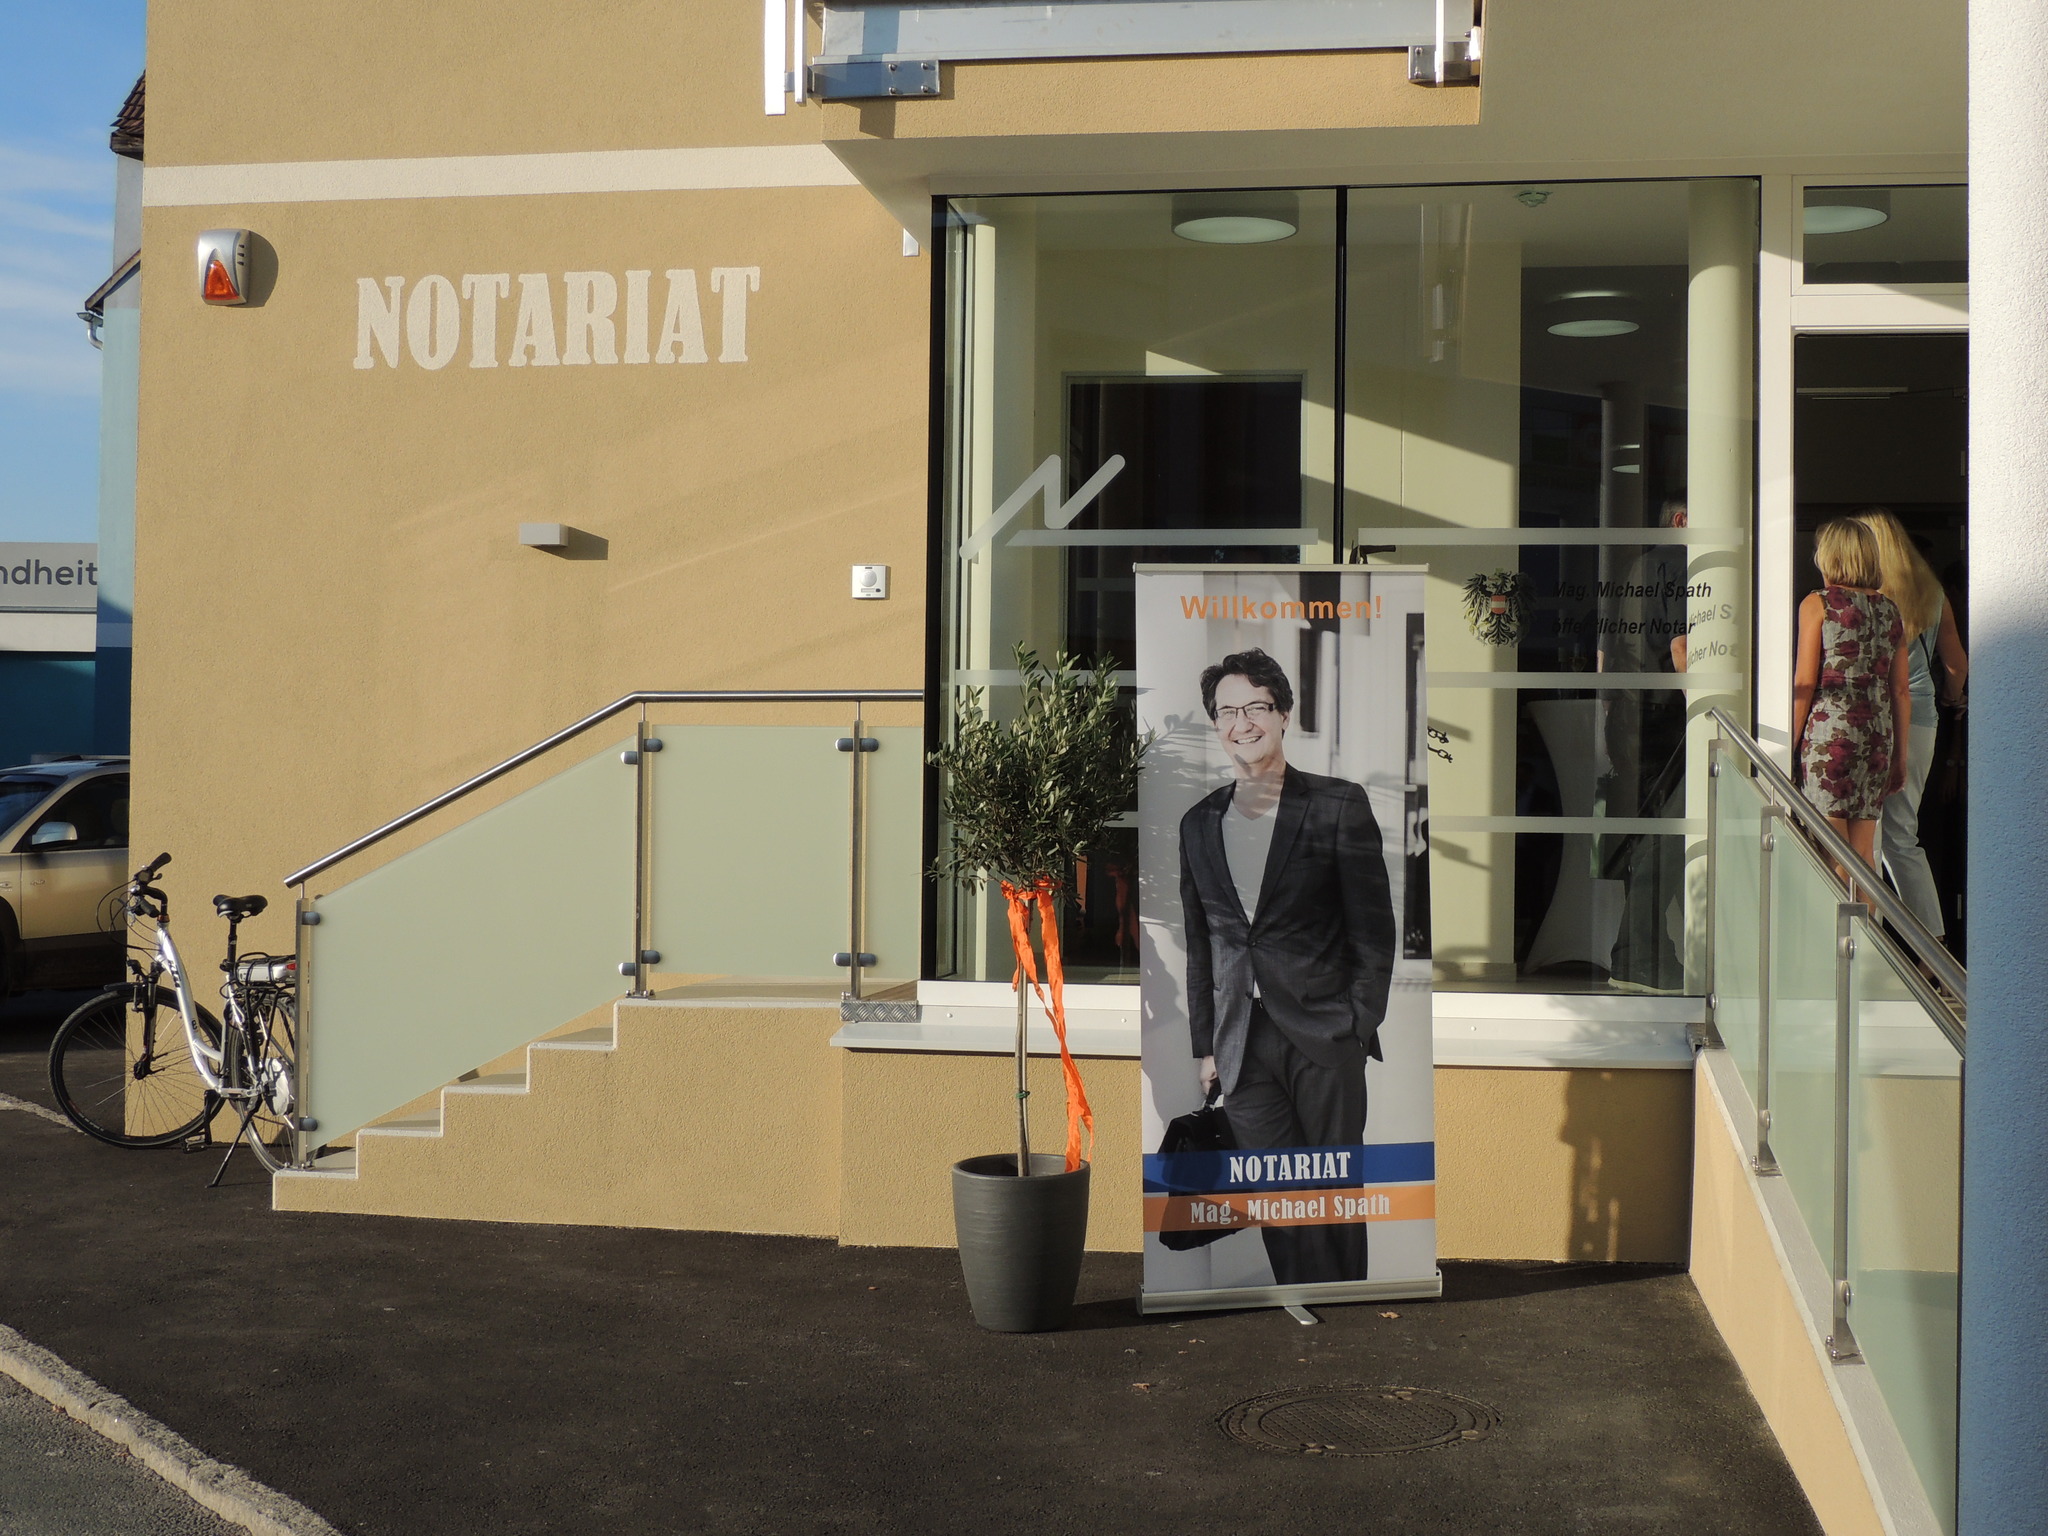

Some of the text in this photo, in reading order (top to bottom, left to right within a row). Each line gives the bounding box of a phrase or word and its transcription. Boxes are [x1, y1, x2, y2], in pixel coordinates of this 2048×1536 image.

[353, 266, 760, 370] NOTARIAT
[1552, 581, 1712, 601] Mag. Michael Spath
[1180, 595, 1383, 620] Willkommen!
[1650, 618, 1697, 634] Notar
[1229, 1151, 1351, 1183] NOTARIAT
[1190, 1193, 1391, 1225] Mag. Michael Spath
